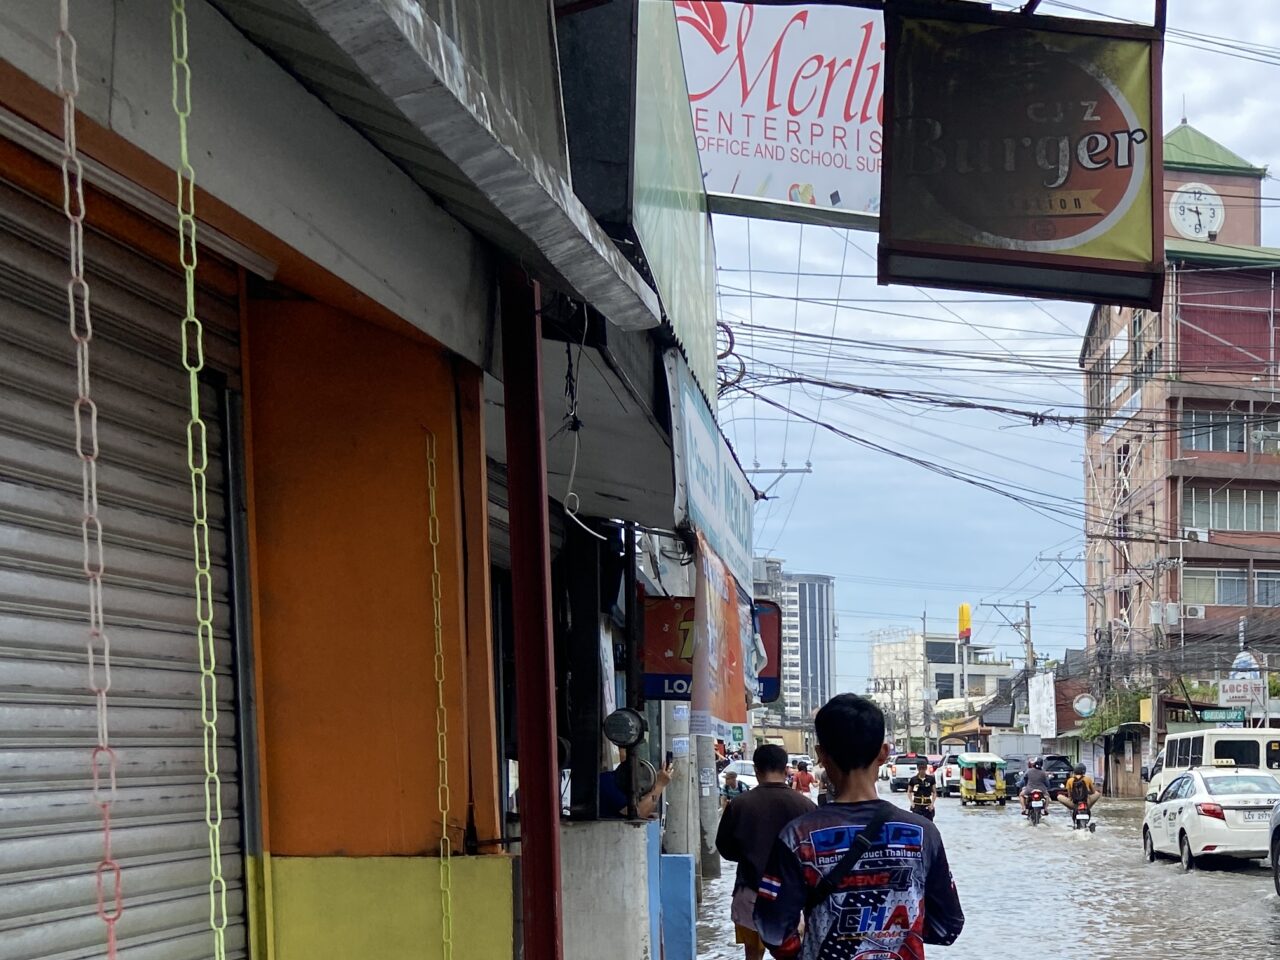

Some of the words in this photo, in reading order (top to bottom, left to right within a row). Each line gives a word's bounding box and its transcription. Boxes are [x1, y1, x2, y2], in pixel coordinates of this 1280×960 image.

[696, 135, 750, 157] OFFICE
[753, 143, 785, 161] AND
[789, 149, 852, 170] SCHOOL
[896, 117, 1148, 188] Burger
[1193, 190, 1202, 201] 12
[1179, 205, 1185, 216] 9
[1209, 207, 1215, 219] 3
[1194, 223, 1201, 234] 6
[884, 847, 922, 858] Thailand
